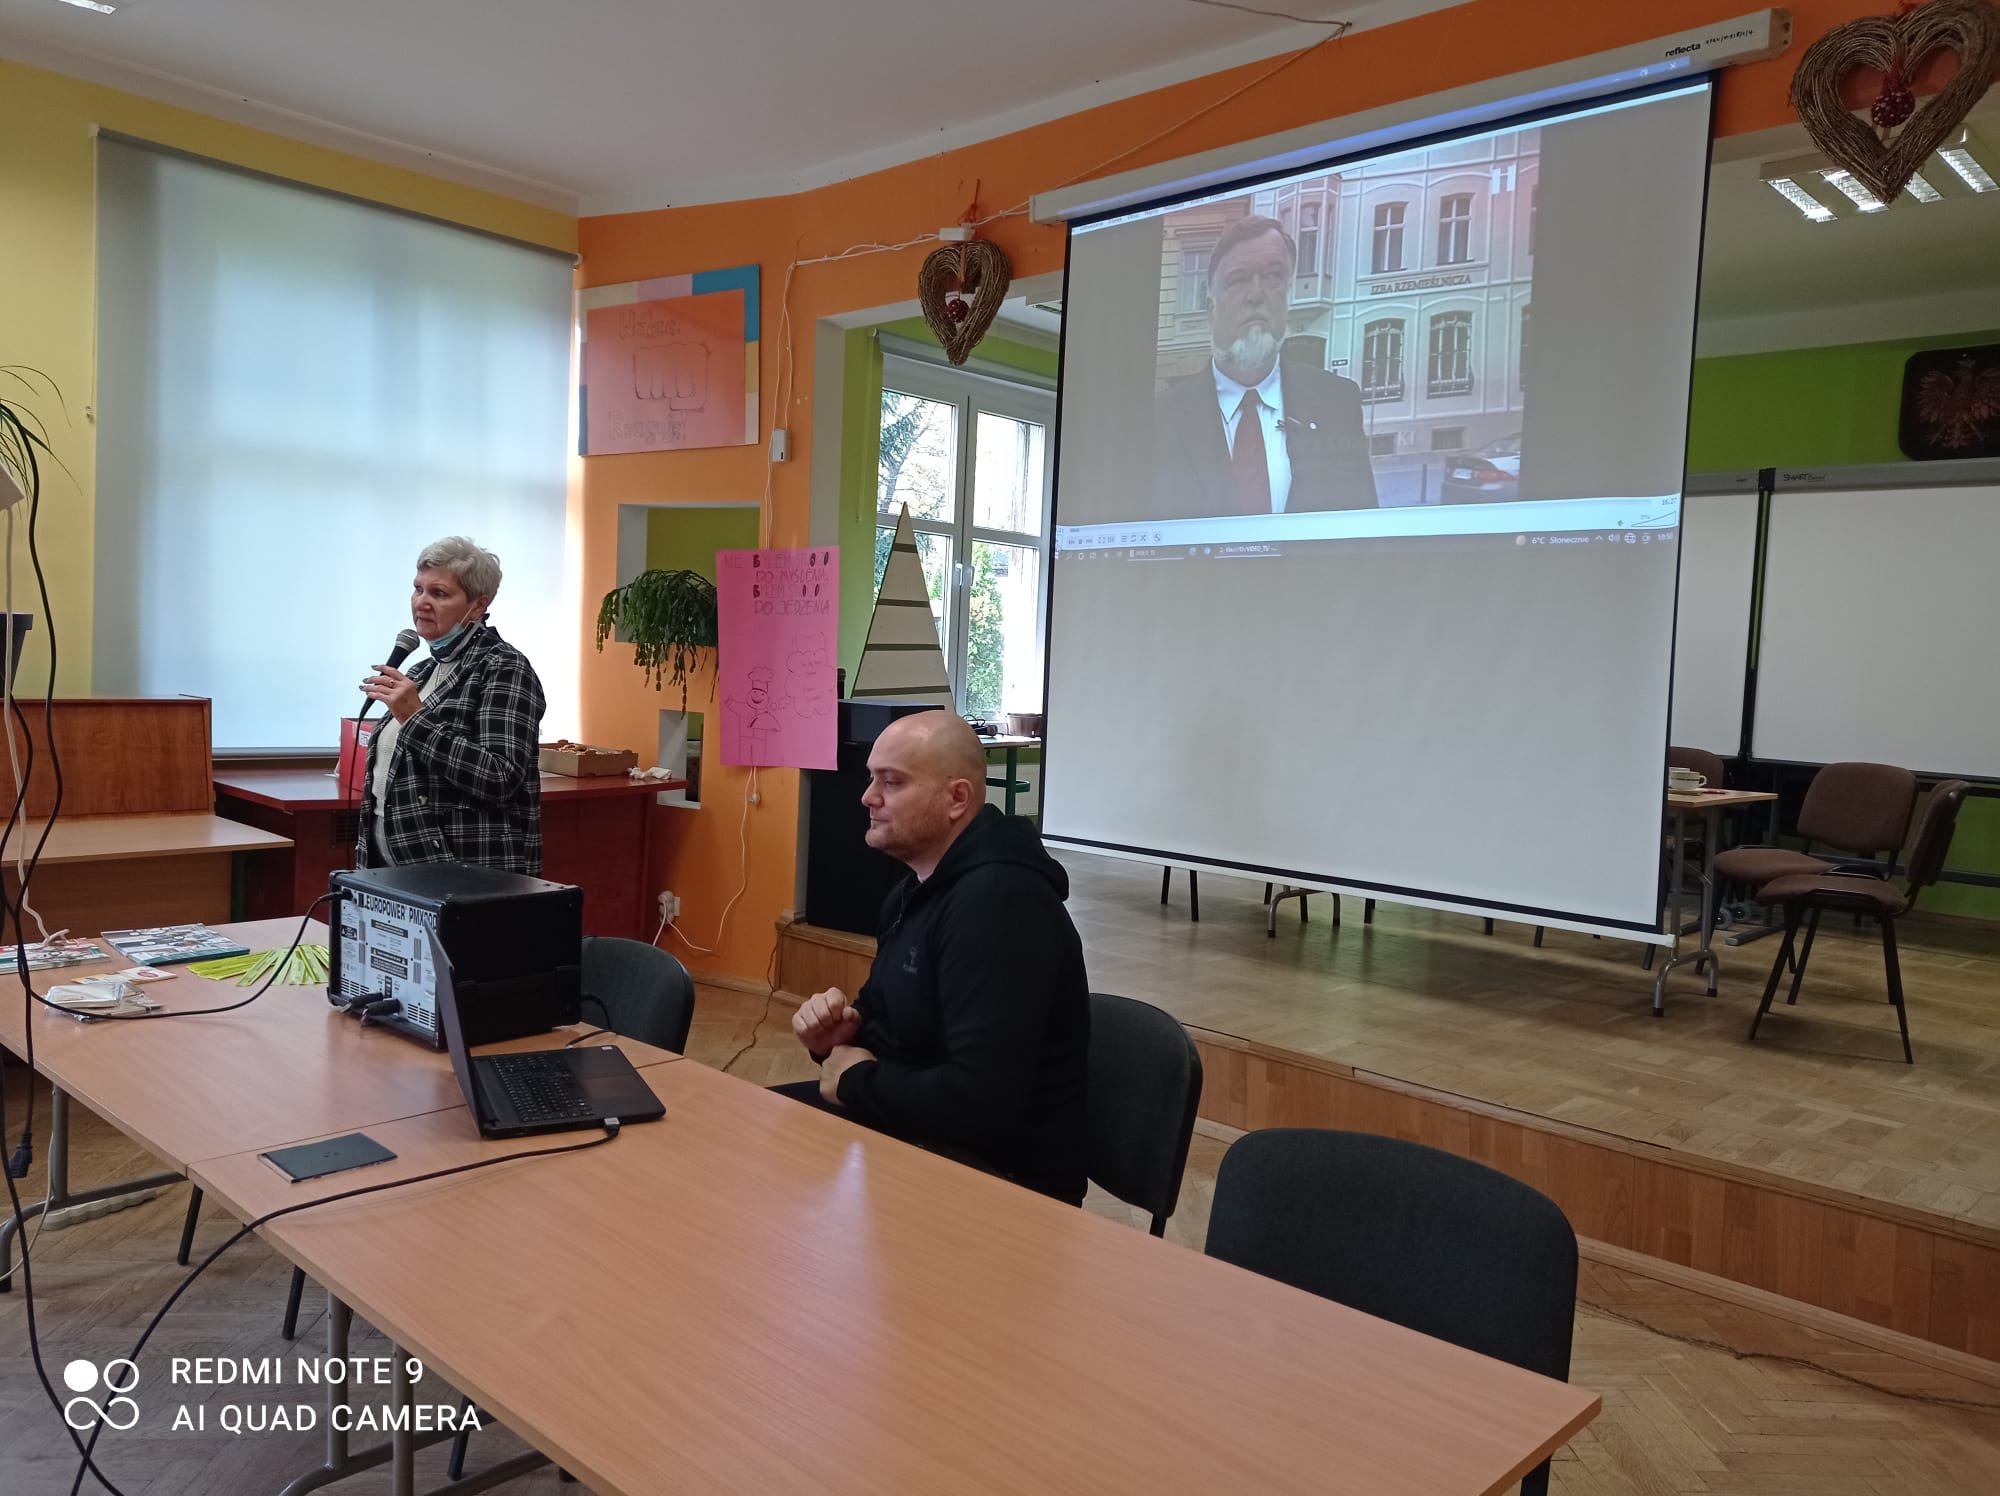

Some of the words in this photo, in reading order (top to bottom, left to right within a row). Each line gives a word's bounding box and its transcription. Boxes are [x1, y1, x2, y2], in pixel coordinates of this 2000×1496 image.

[1665, 43, 1701, 58] reflecta
[1371, 282, 1393, 295] IZBA
[755, 570, 774, 583] DO
[754, 600, 774, 615] DO
[366, 895, 406, 920] EUROPOWER
